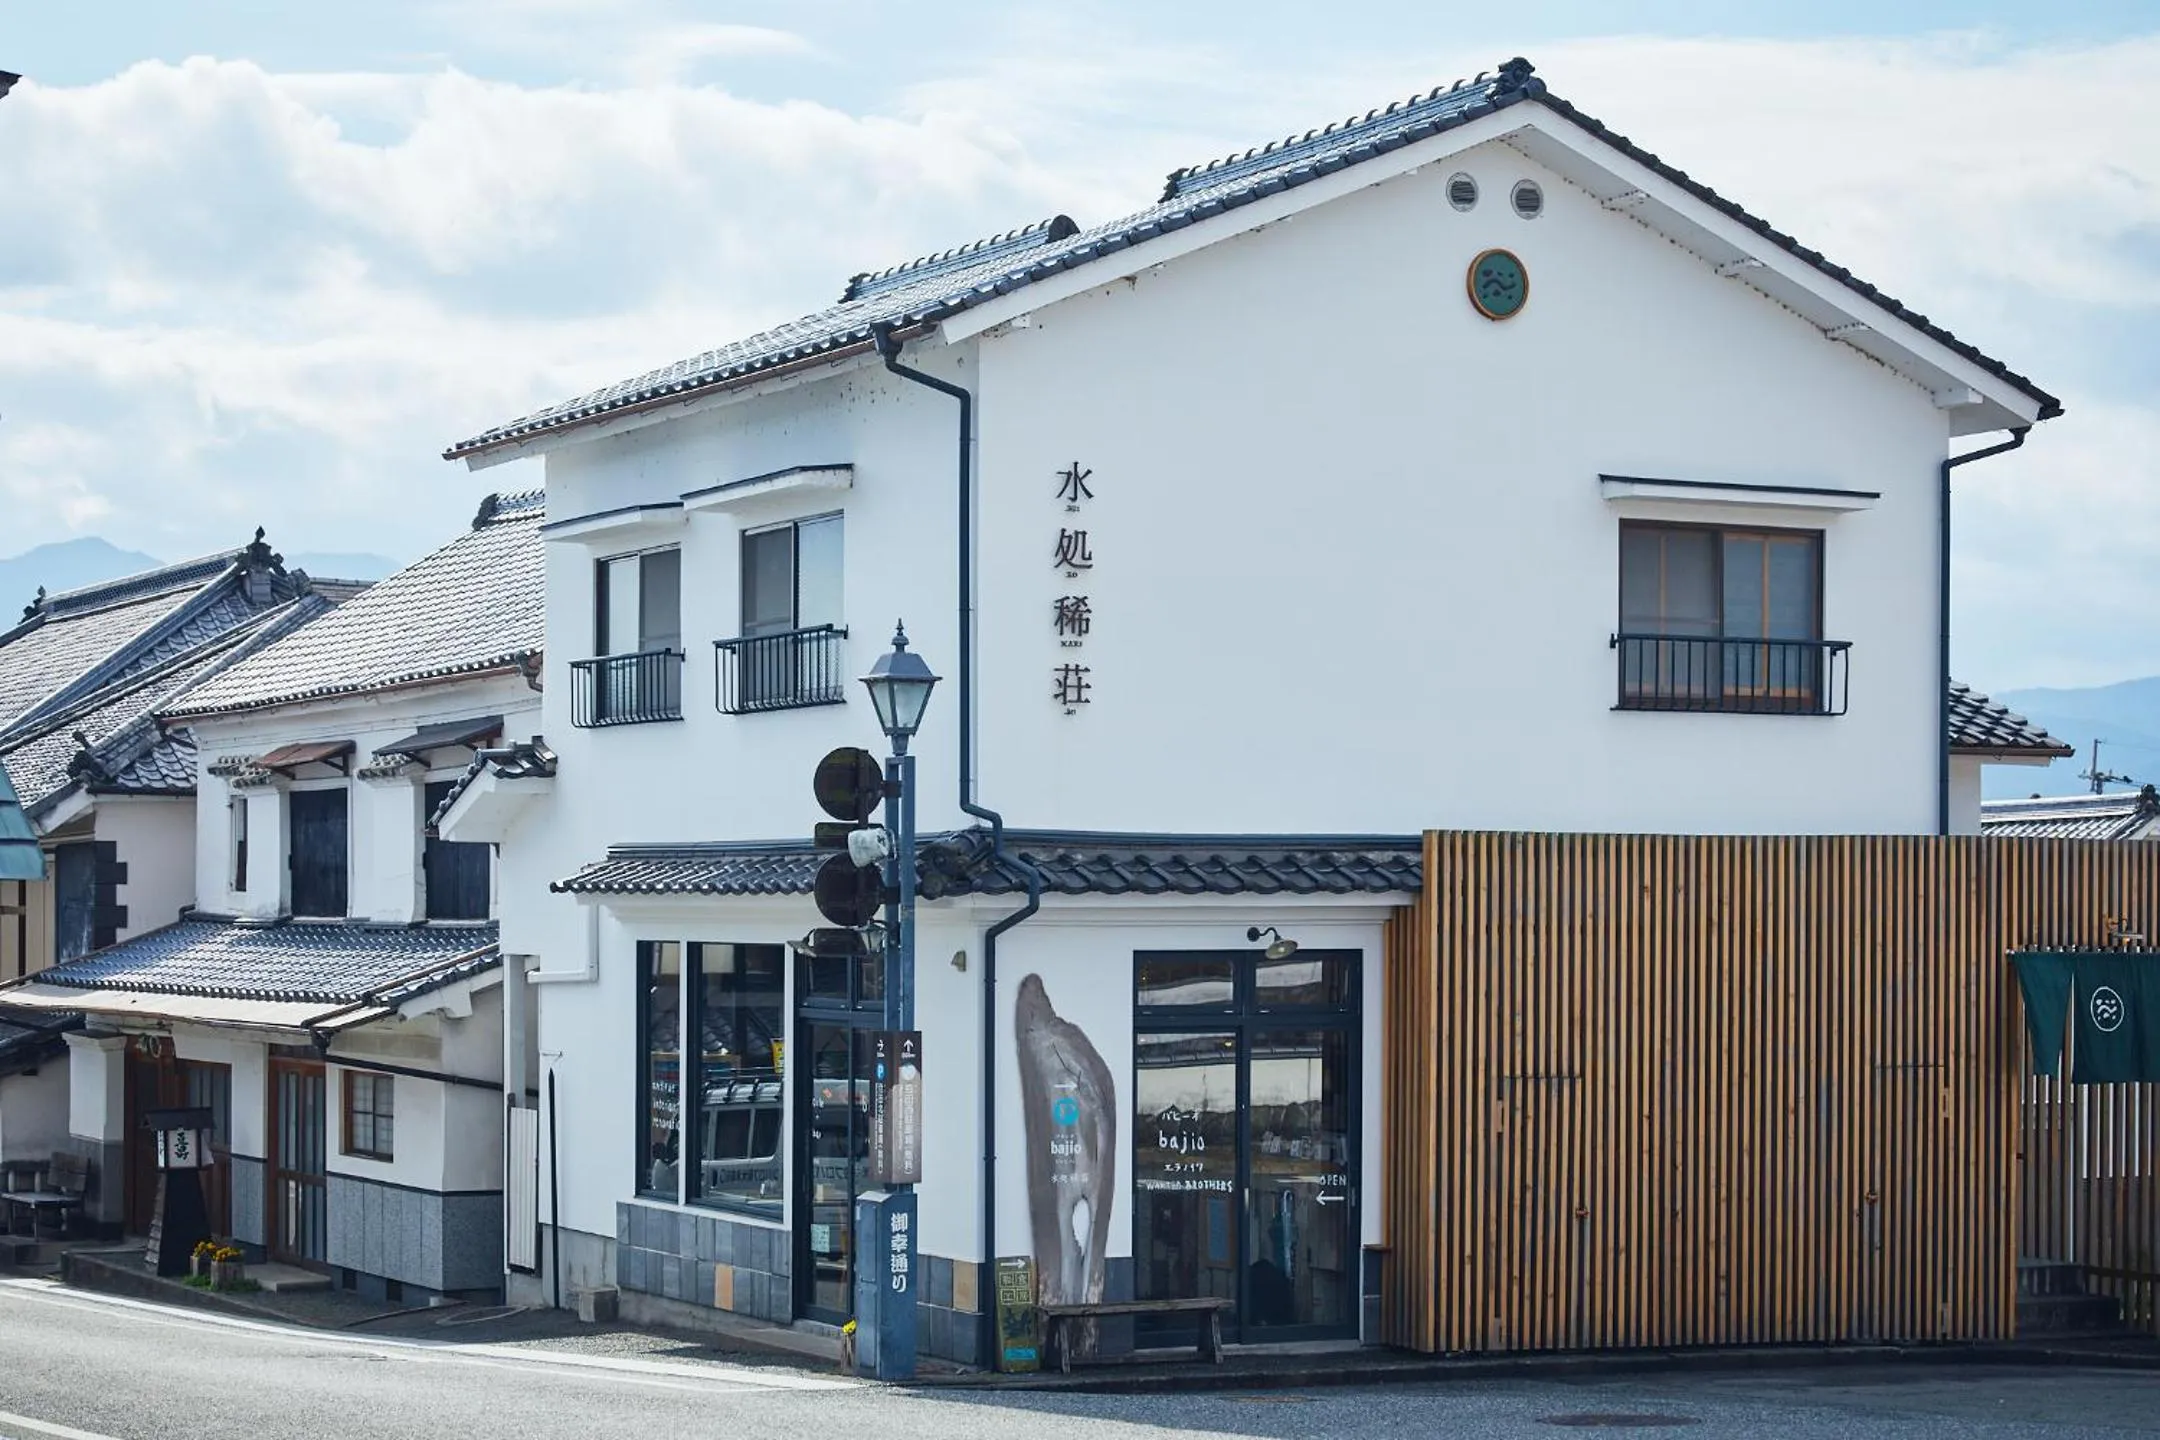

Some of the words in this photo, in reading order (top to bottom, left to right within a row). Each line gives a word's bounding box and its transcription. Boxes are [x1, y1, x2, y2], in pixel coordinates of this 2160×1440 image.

[1050, 1140, 1082, 1156] bajio
[1158, 1129, 1206, 1154] bajio
[1184, 1180, 1233, 1193] BROTHERS
[1320, 1174, 1347, 1186] OPEN
[890, 1211, 909, 1293] 御幸通り
